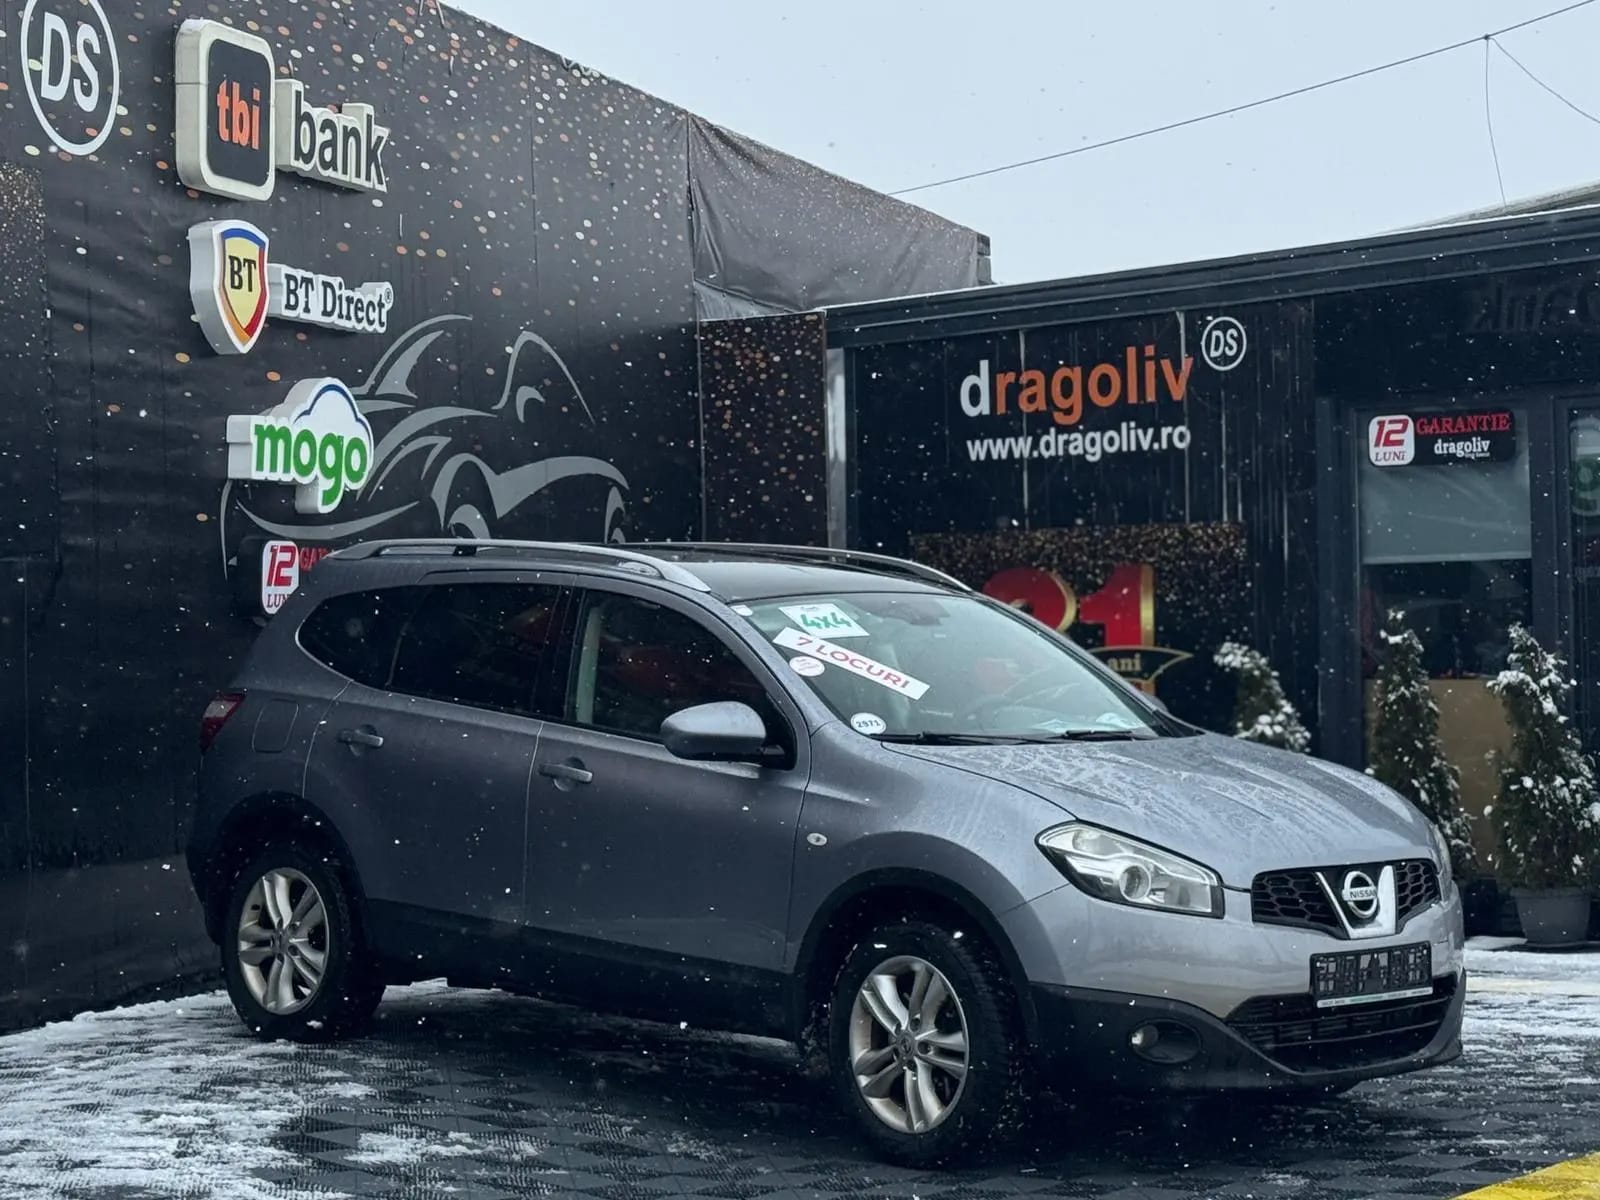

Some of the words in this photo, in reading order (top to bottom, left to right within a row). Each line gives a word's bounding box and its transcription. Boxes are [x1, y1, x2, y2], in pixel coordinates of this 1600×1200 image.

[40, 12, 101, 112] DS
[216, 80, 261, 150] tbi
[294, 91, 386, 186] bank
[228, 255, 257, 293] BT
[284, 272, 314, 314] BT
[1209, 330, 1239, 359] DS
[960, 346, 1193, 425] dragoliv
[966, 421, 1191, 462] www.dragoliv.ro
[1374, 419, 1409, 448] 12
[1416, 413, 1510, 435] GARANTIE
[1434, 437, 1490, 457] dragoliv
[254, 424, 367, 506] mogo
[267, 545, 296, 587] 12
[797, 636, 813, 646] 7
[816, 645, 910, 688] LOCURI
[1107, 653, 1142, 672] ani
